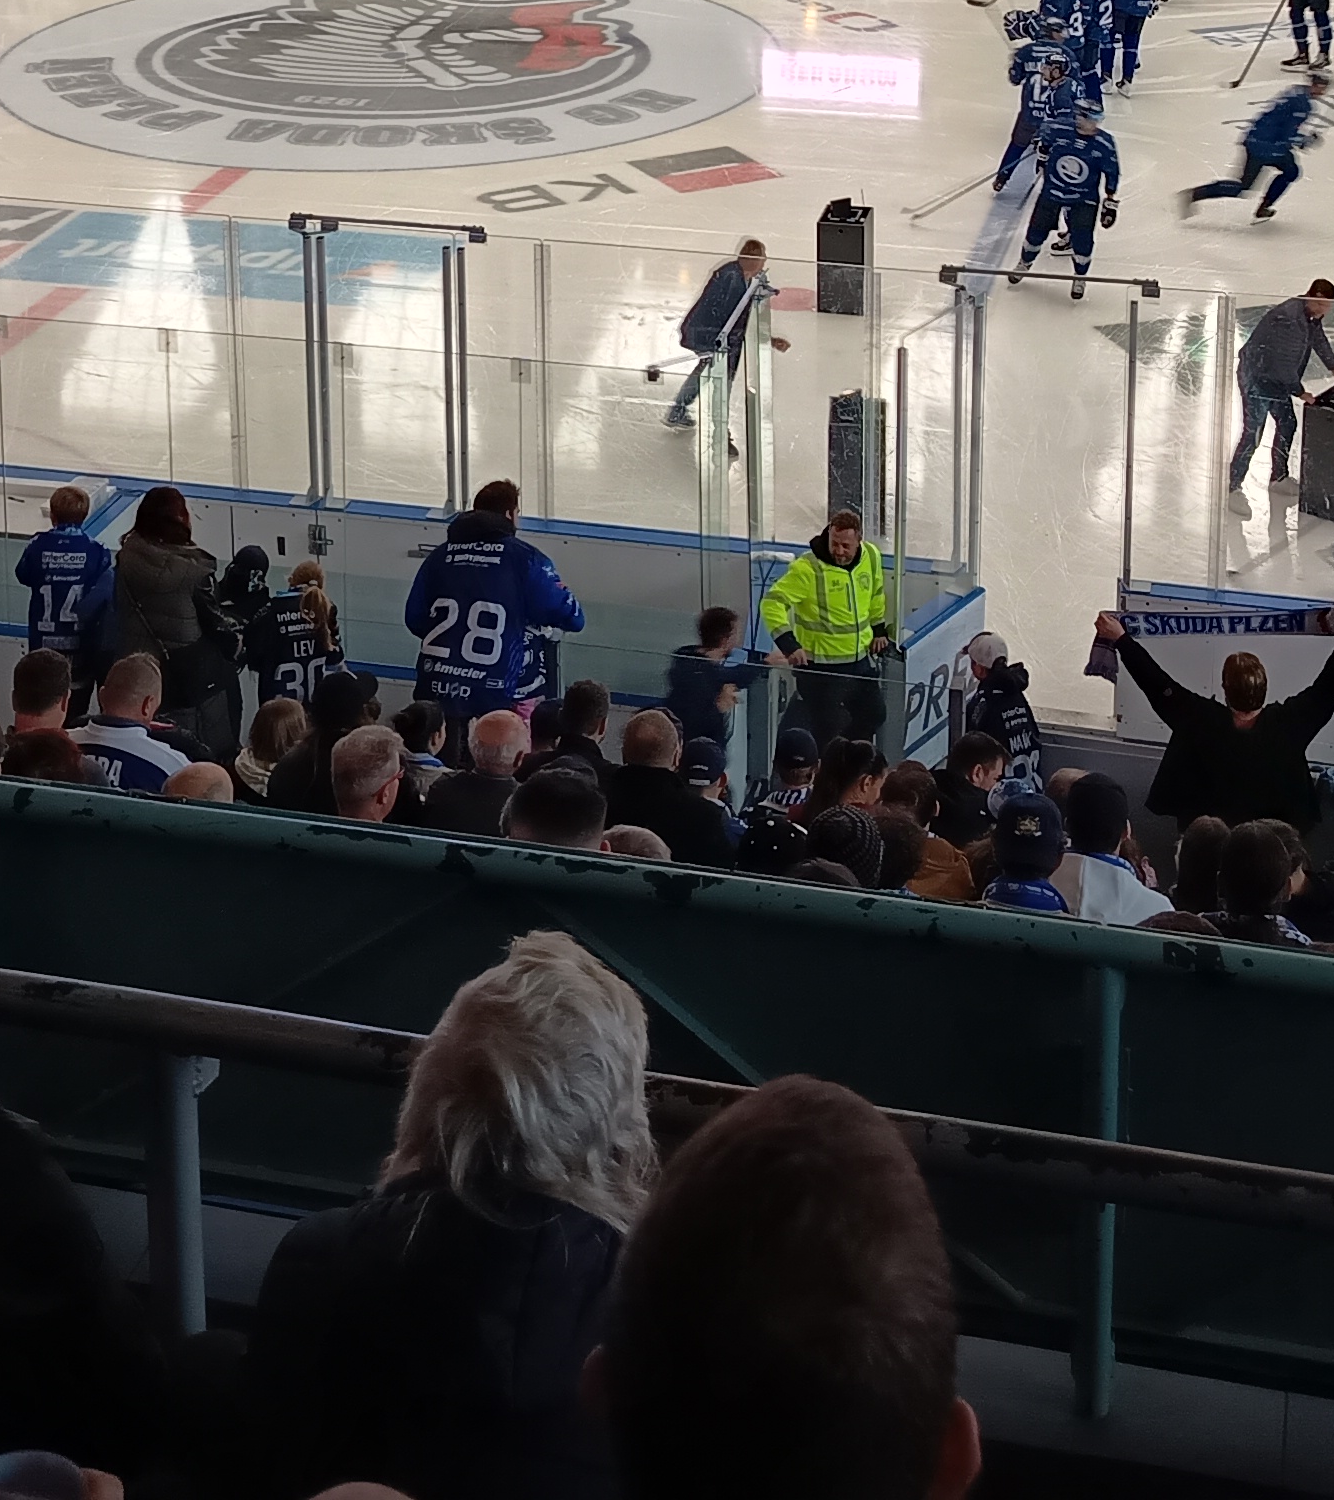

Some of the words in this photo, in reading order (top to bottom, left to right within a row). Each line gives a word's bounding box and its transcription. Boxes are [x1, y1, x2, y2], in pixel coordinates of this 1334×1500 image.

[25, 56, 223, 133] PLZEŇ
[293, 92, 371, 108] 1929
[567, 88, 697, 126] HC
[226, 117, 556, 150] ŠKODA
[475, 173, 637, 213] KB
[293, 640, 315, 657] LEV
[422, 598, 506, 666] 28
